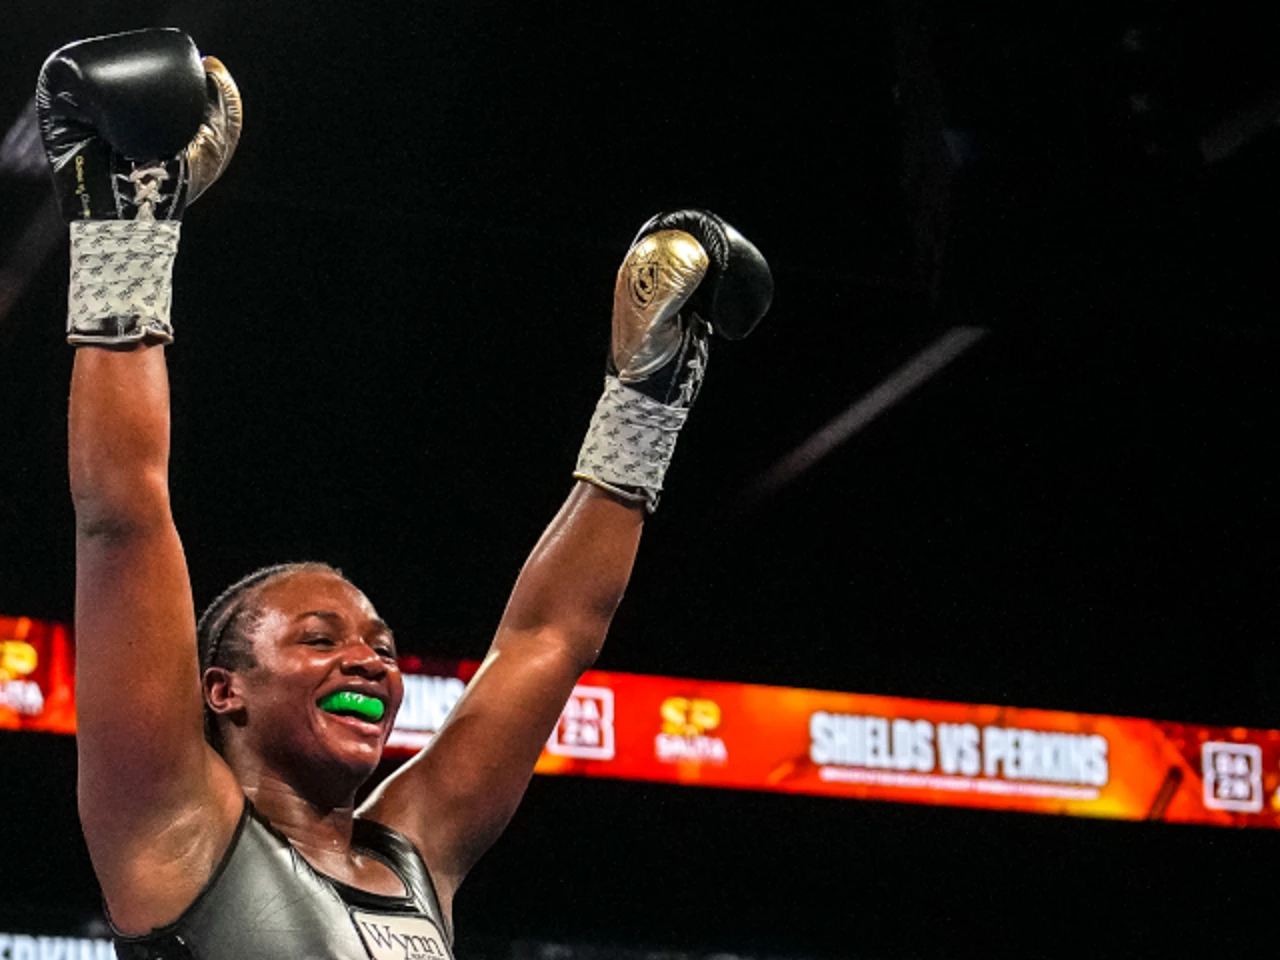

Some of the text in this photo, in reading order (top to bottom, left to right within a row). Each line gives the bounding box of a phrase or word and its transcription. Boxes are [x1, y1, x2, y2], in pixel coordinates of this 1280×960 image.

[656, 733, 727, 759] SALITA
[810, 711, 934, 770] SHIELDS
[938, 721, 978, 775] VS
[983, 725, 1108, 786] PERKINS
[361, 921, 444, 960] Wynn
